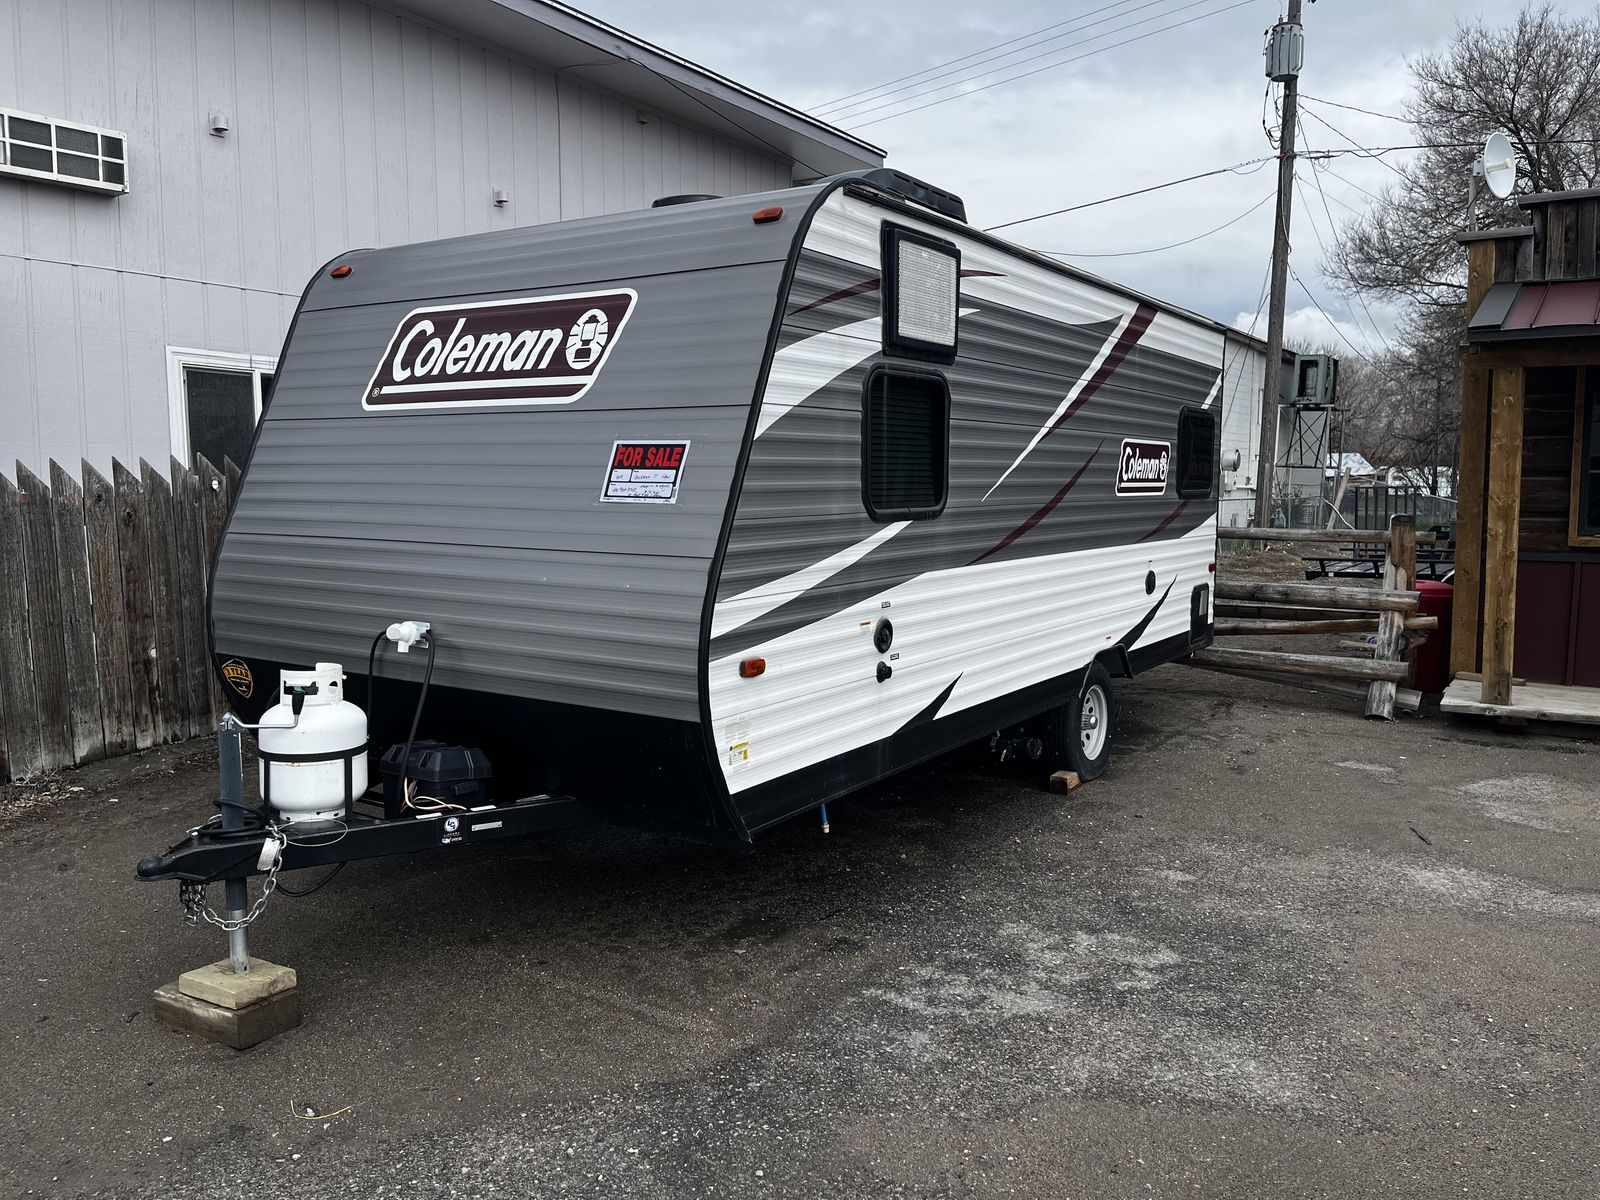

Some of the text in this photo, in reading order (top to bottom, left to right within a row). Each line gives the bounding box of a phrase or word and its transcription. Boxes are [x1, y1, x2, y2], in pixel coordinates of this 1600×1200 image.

[392, 317, 564, 382] Coleman
[614, 447, 683, 467] FOR SALE
[1122, 446, 1160, 481] Coleman
